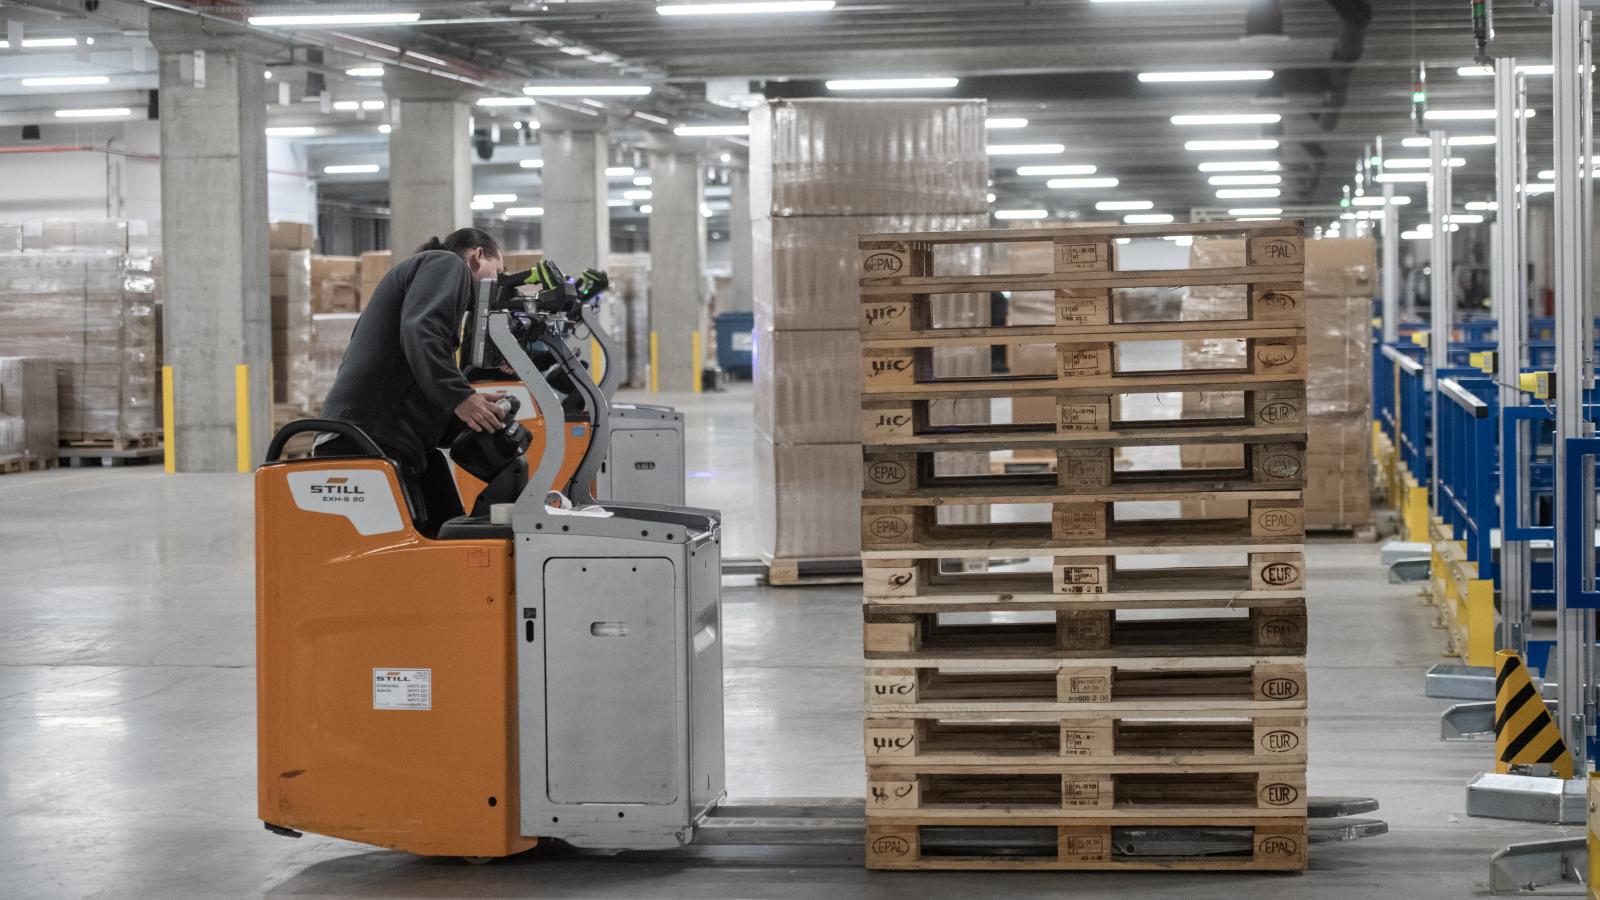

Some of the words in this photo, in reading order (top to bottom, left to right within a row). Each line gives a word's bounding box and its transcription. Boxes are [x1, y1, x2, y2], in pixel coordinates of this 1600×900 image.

[1268, 406, 1289, 421] EUR
[874, 466, 900, 480] EPAL
[310, 485, 365, 494] STILL
[876, 520, 900, 534] EPAL
[1265, 514, 1292, 527] EPAL
[1268, 567, 1291, 581] EUR
[1268, 682, 1292, 696] EUR
[1269, 734, 1291, 749] EUR
[1268, 787, 1290, 801] EUR
[878, 840, 905, 854] EPAL
[1265, 841, 1291, 854] EPAL
